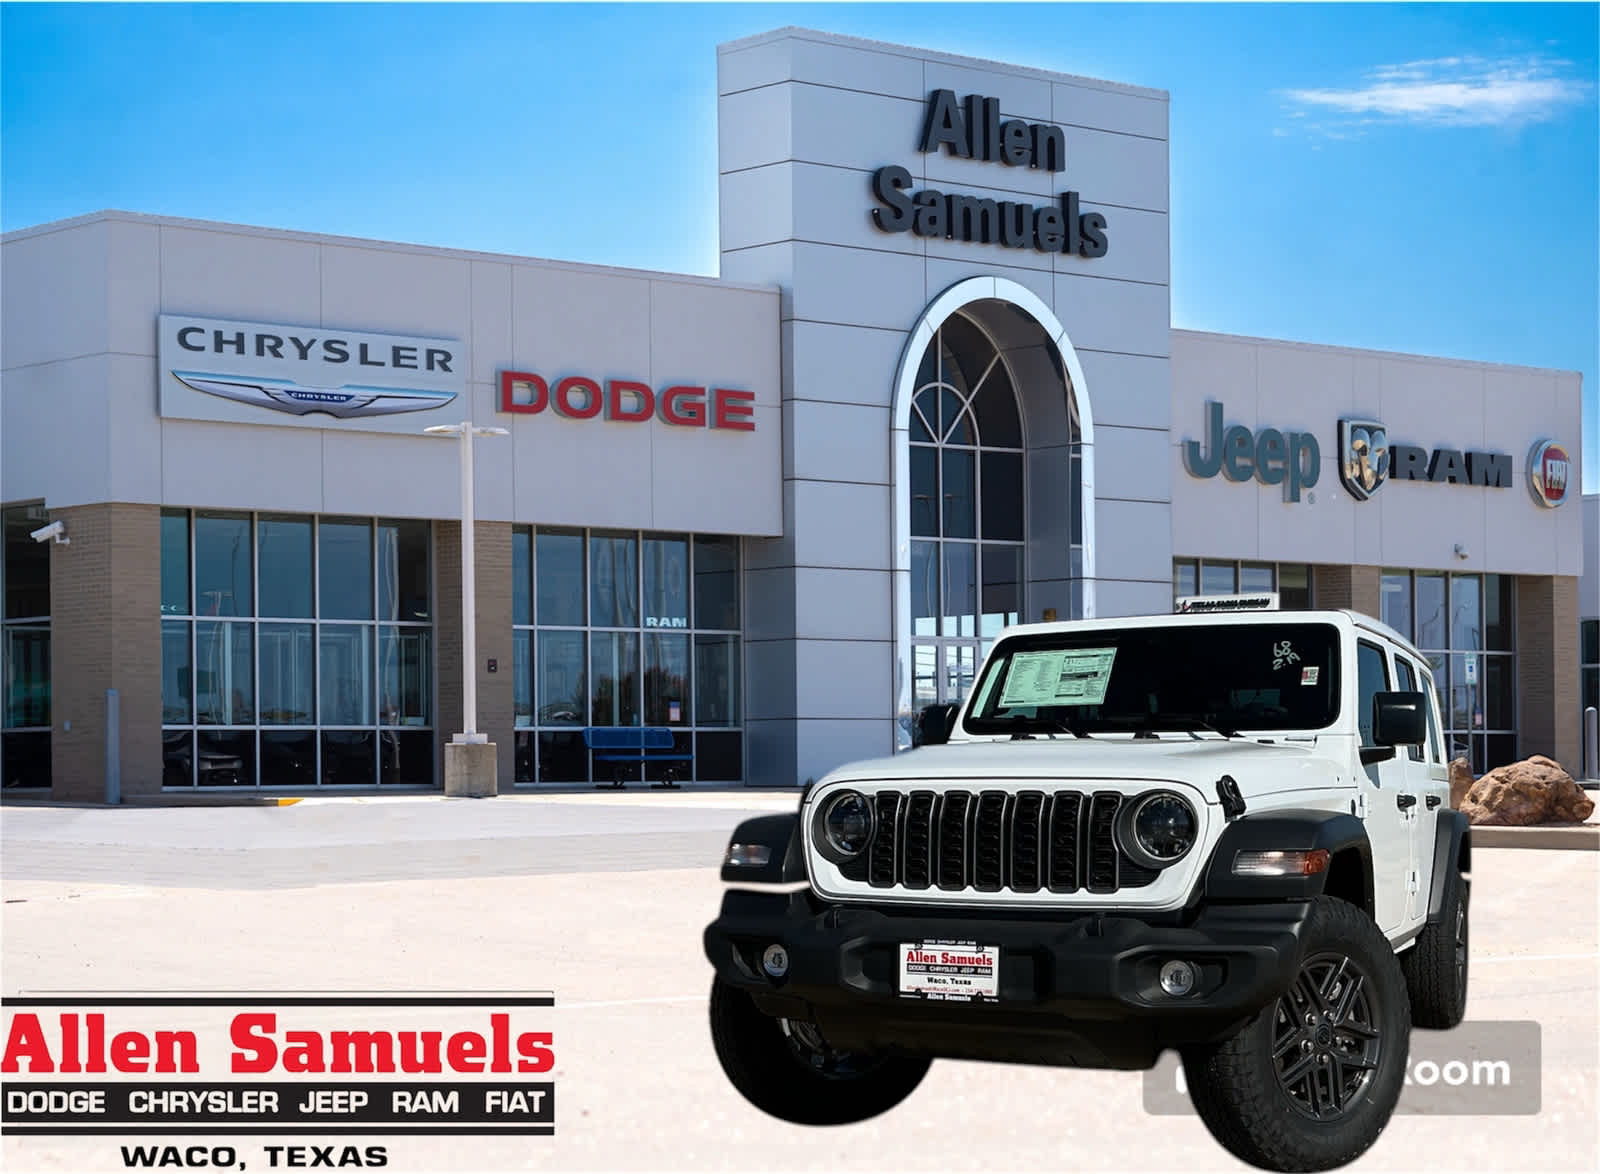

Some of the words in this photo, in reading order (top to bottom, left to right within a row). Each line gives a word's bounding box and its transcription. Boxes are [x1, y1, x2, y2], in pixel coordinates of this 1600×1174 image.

[918, 88, 1066, 172] Allen
[871, 165, 1109, 258] Samuels
[177, 326, 453, 373] CHRYSLER
[291, 392, 347, 401] CHRYSLER
[496, 370, 755, 432] DODGE
[1183, 399, 1320, 503] Jeep
[1389, 444, 1513, 488] RAM
[646, 616, 688, 628] RAM
[906, 950, 937, 963] Allen
[941, 952, 993, 966] Samuels
